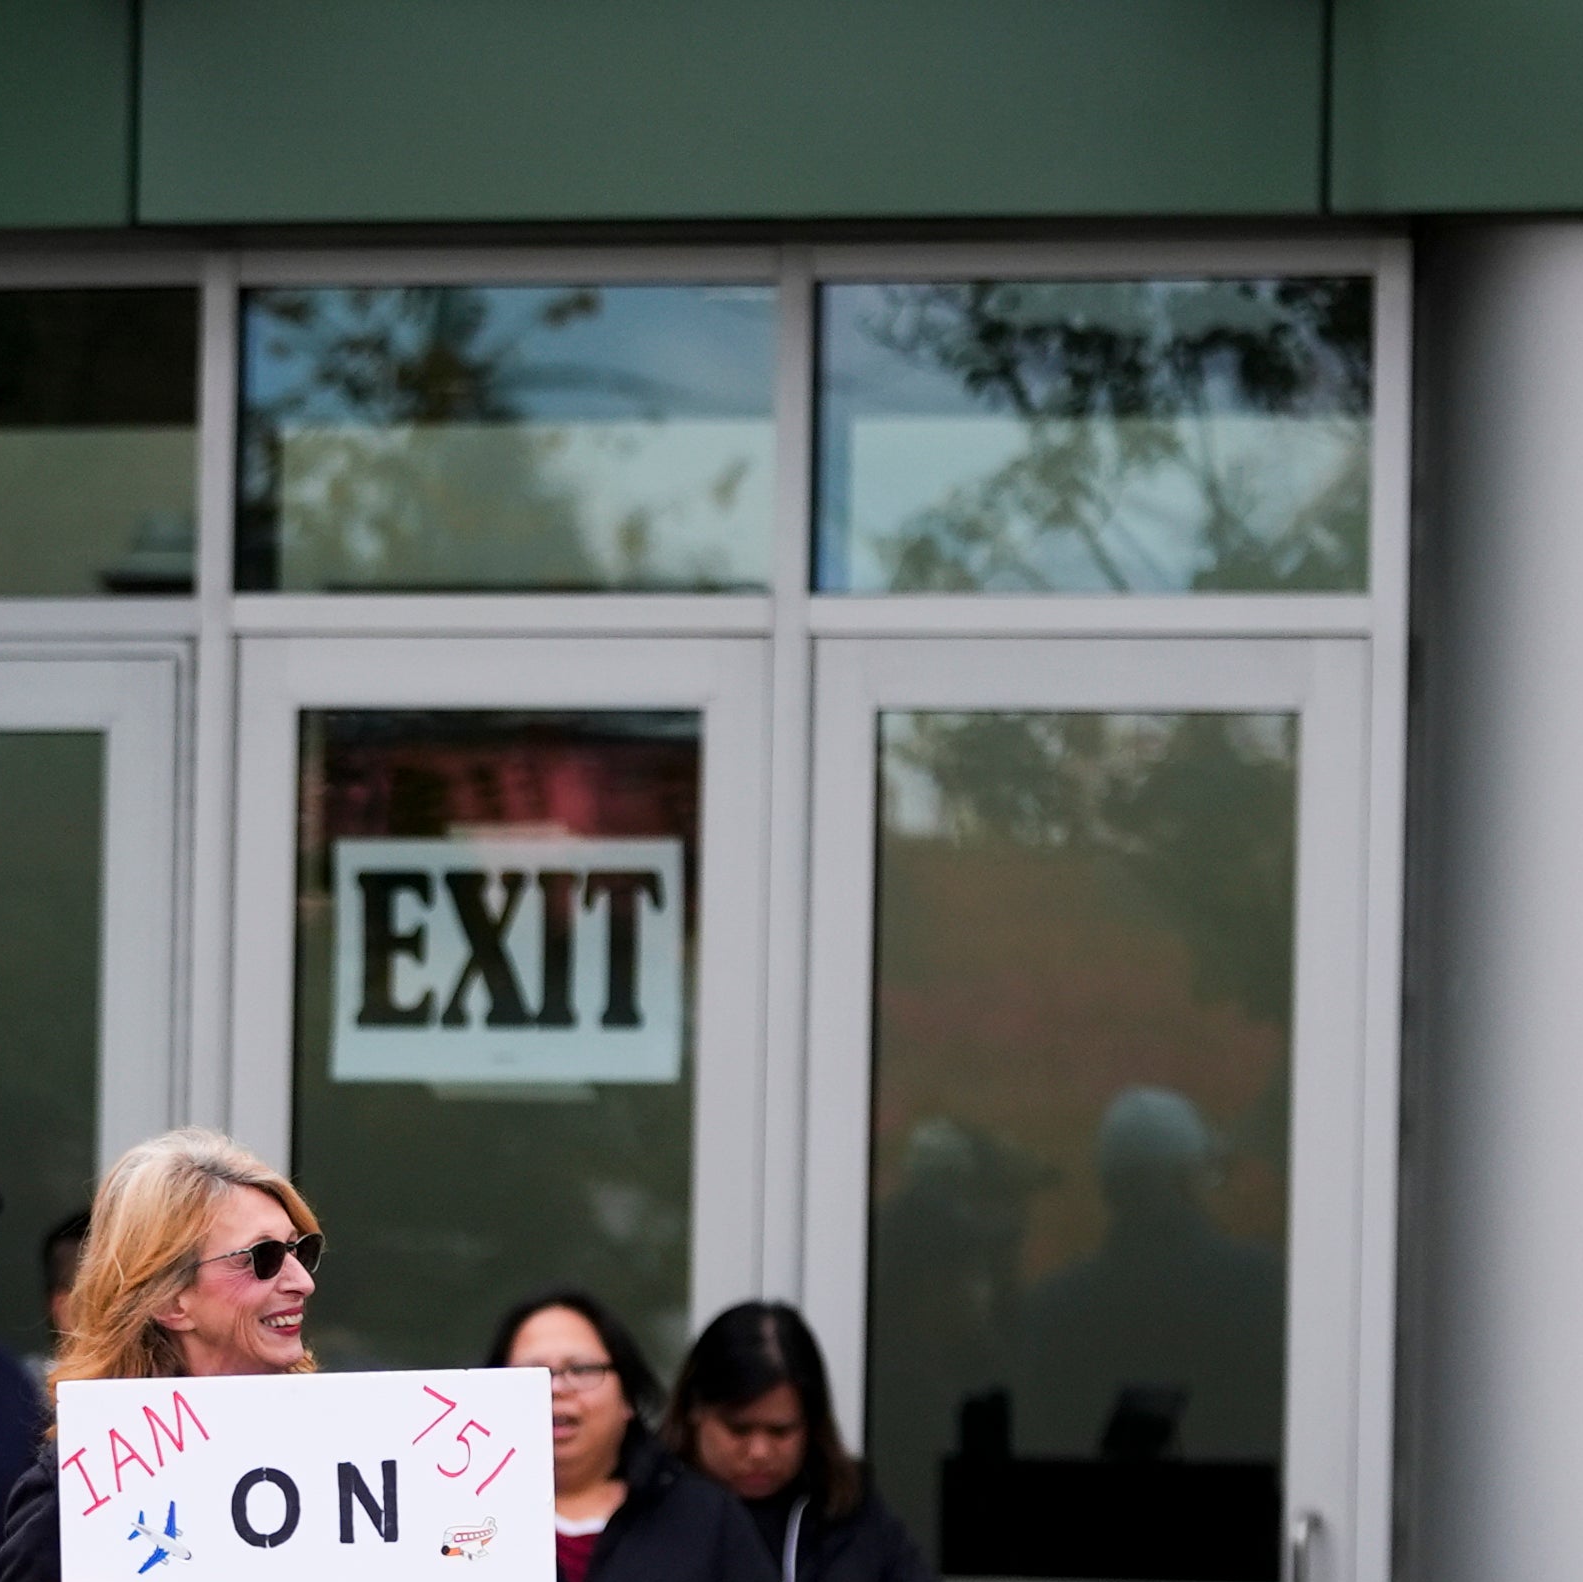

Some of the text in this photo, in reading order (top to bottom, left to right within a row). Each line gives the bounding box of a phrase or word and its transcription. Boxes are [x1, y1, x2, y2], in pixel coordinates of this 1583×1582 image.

[357, 871, 665, 1027] EXIT
[61, 1390, 210, 1517] IAM
[412, 1384, 516, 1497] 751
[231, 1459, 399, 1548] ON
